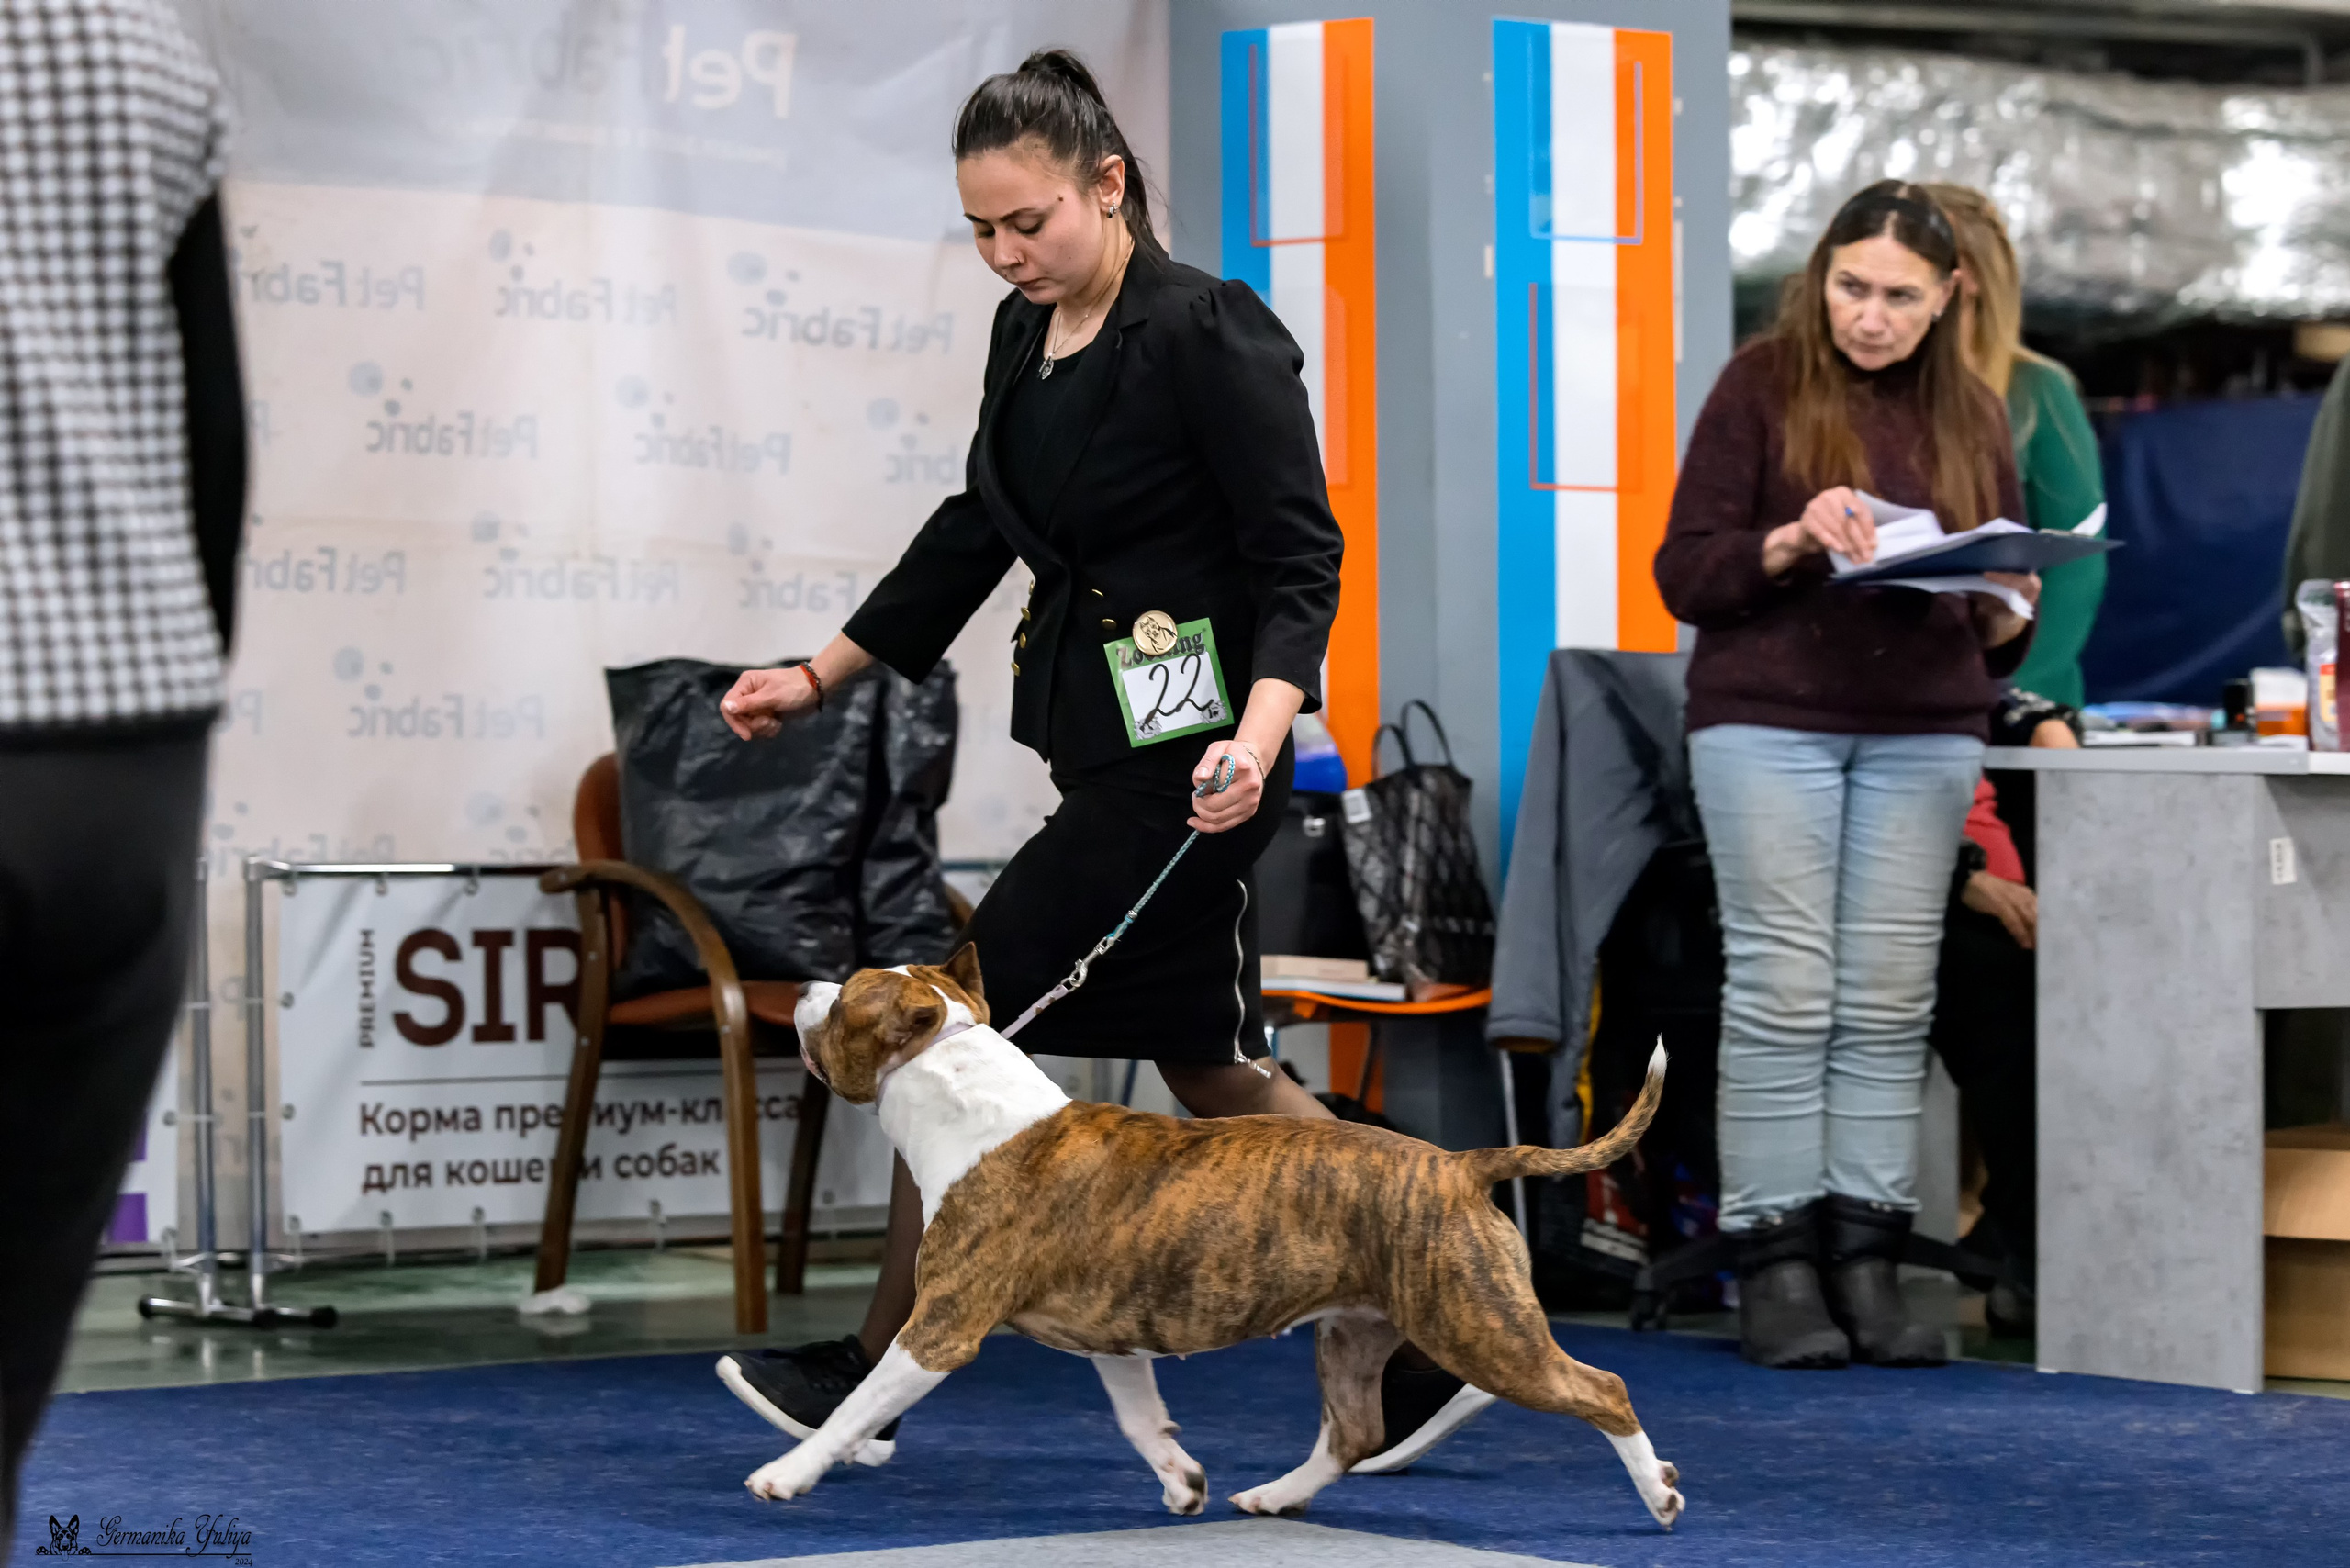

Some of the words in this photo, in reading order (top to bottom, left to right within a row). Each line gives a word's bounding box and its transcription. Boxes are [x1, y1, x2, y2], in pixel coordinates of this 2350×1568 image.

[1144, 653, 1214, 723] 22
[359, 929, 375, 1047] PREMIUM
[360, 1103, 482, 1142] Корма
[363, 1162, 432, 1193] для
[446, 1157, 554, 1187] коше
[613, 1143, 721, 1180] собак
